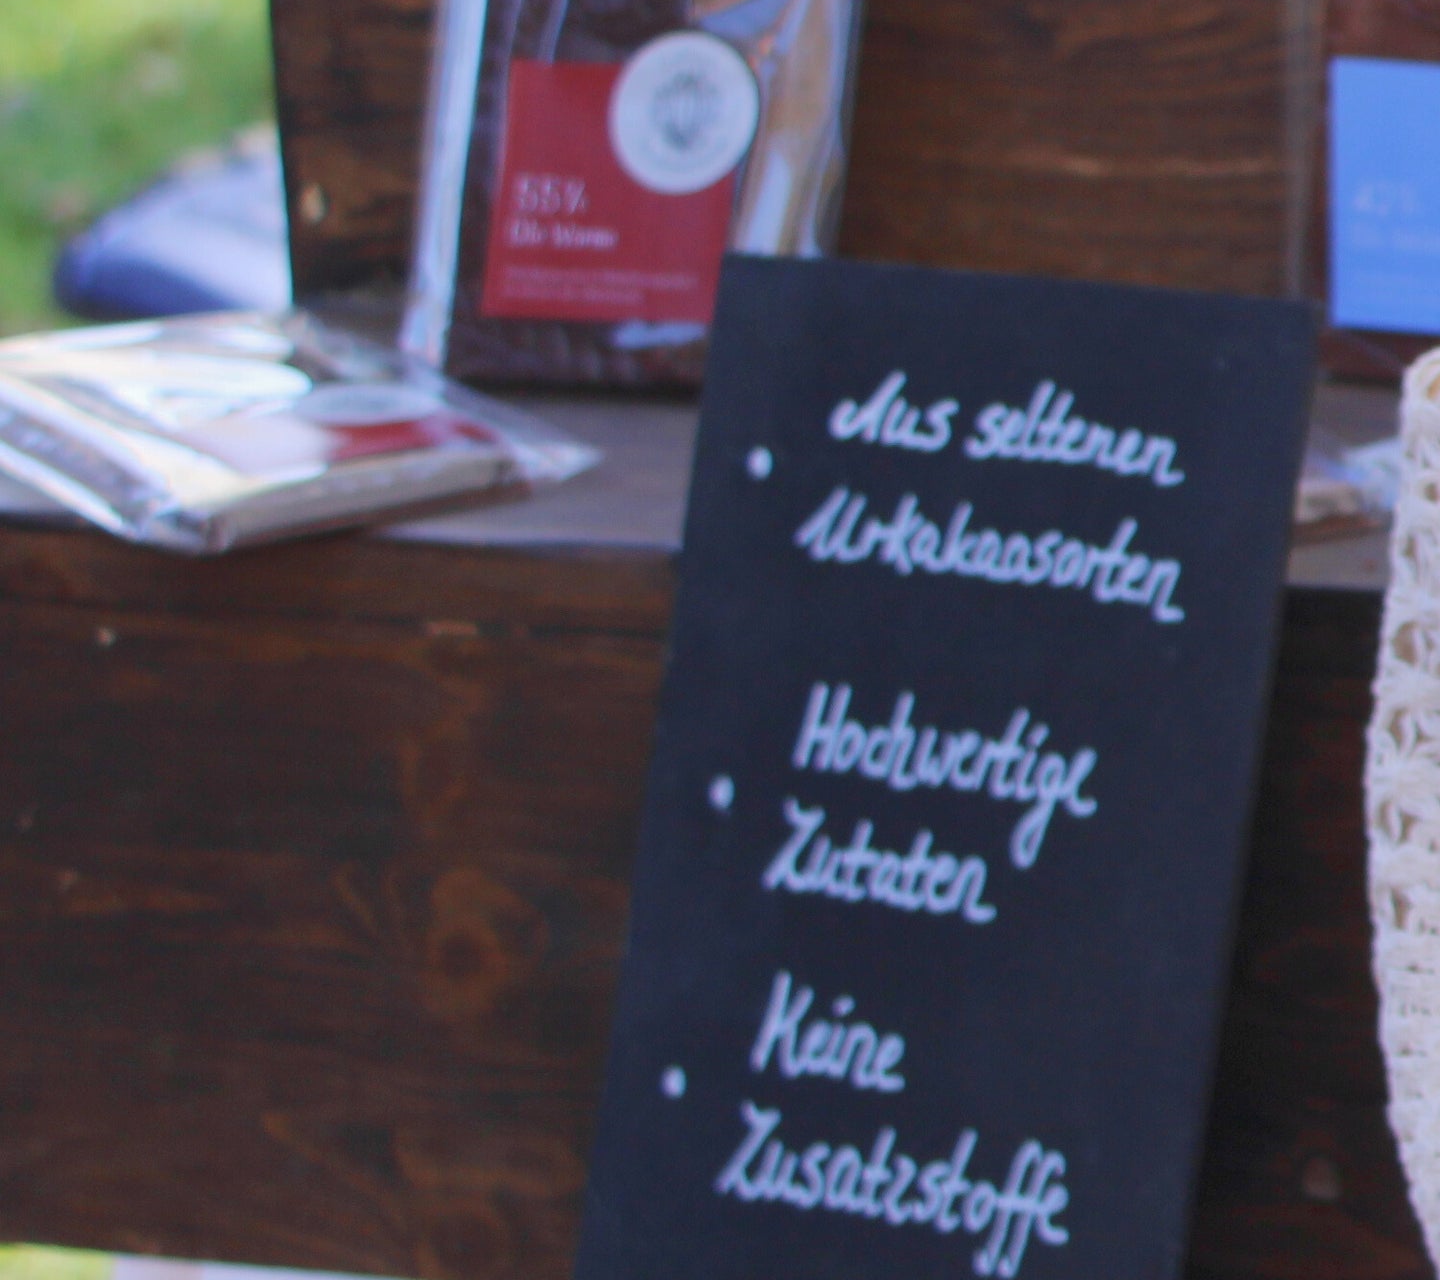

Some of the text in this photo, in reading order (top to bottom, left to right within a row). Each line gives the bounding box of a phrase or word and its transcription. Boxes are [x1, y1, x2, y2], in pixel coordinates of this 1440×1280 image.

[830, 370, 1185, 486] Aus seltenen
[793, 681, 1098, 869] Hochwertige
[762, 796, 997, 923] Zutaten
[749, 969, 906, 1093] Keine
[713, 1099, 1070, 1279] Zusatzstoffe
